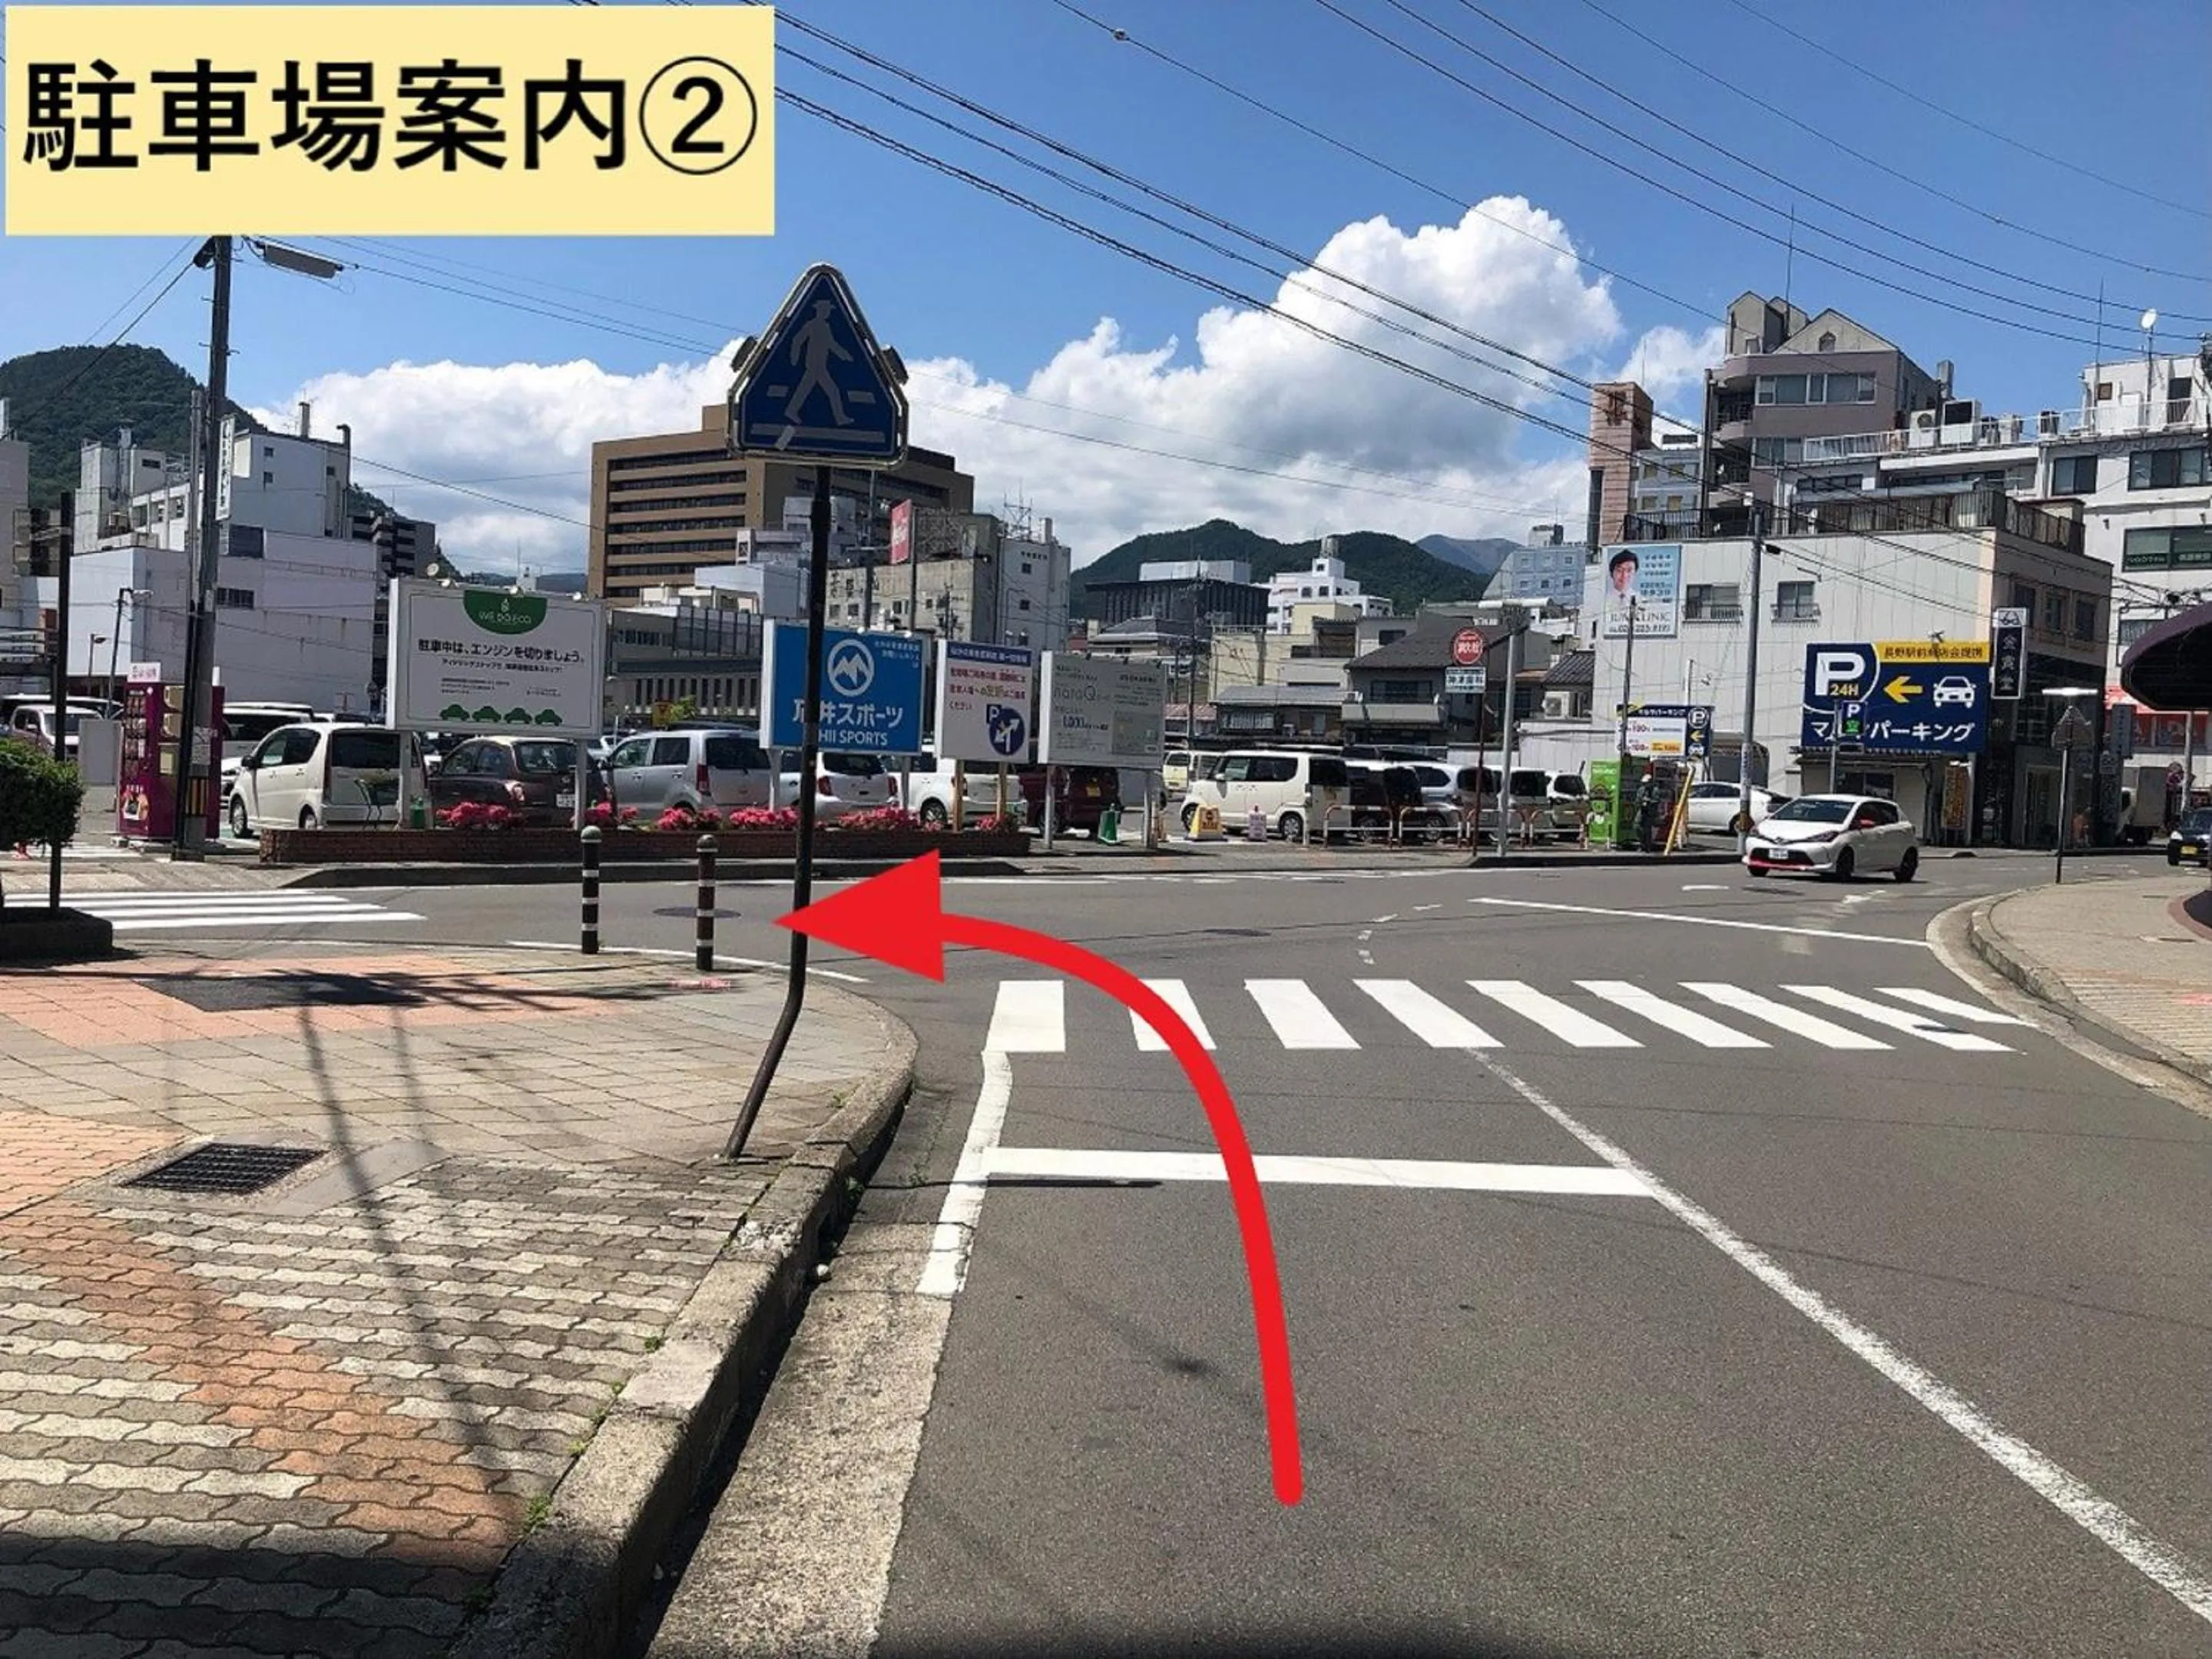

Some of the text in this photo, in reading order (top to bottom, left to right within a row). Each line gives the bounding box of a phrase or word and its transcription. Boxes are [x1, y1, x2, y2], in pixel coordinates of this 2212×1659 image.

[418, 638, 584, 664] 駐車中は、エンジンを切りましょう。
[1830, 683, 1859, 697] 24H
[839, 730, 888, 746] SPORTS
